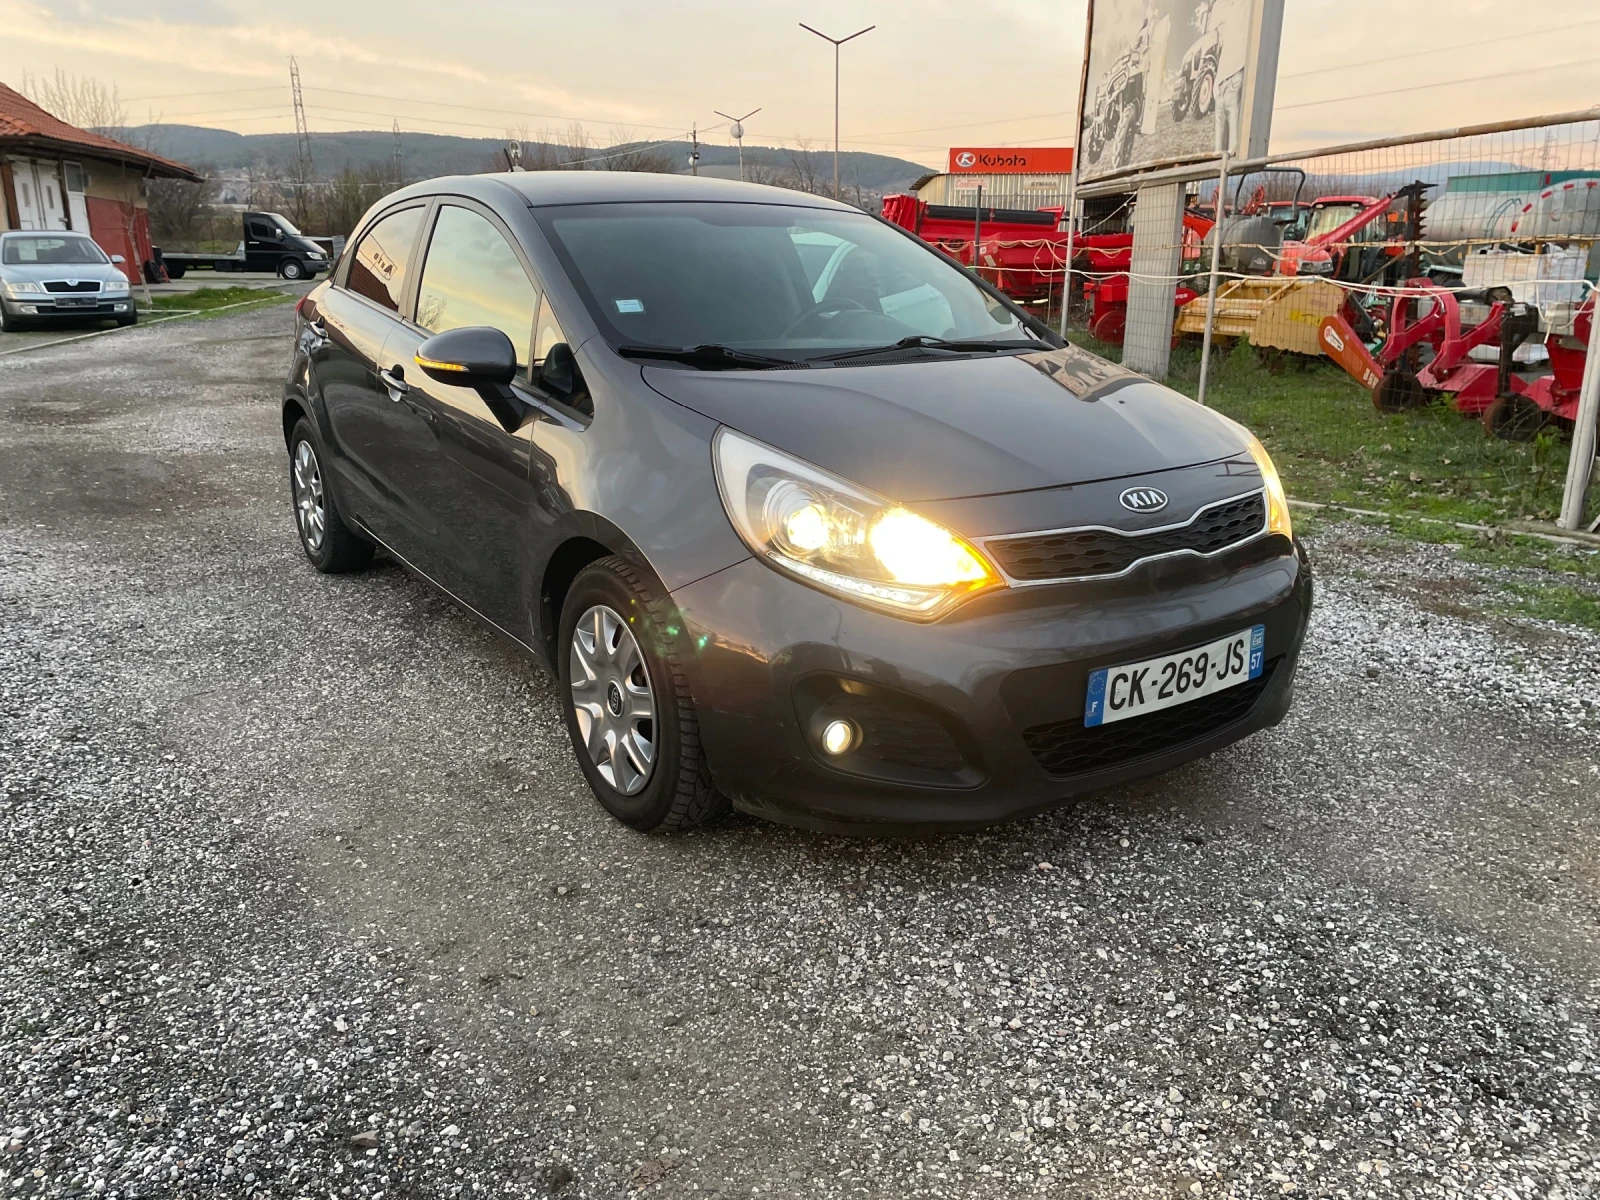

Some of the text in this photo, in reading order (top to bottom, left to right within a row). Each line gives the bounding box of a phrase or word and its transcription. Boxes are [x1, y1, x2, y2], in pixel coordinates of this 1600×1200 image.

[979, 154, 1026, 167] Kubota
[1126, 490, 1164, 508] KIA
[1250, 651, 1262, 670] 57
[1109, 638, 1245, 711] CK-269-JS
[1091, 700, 1099, 713] F
